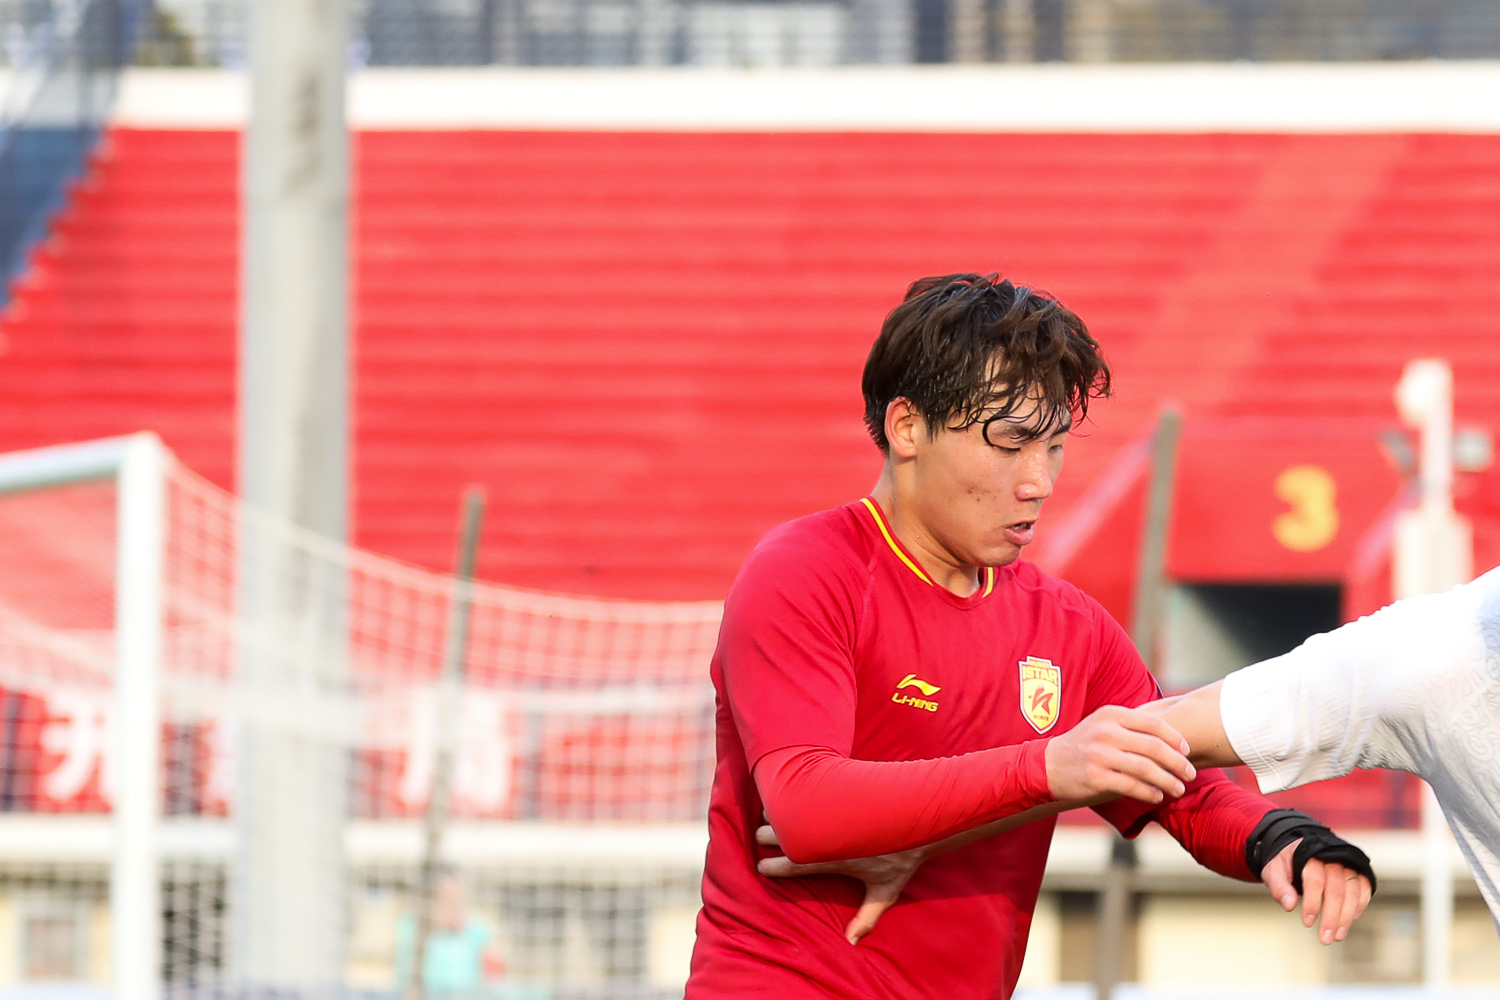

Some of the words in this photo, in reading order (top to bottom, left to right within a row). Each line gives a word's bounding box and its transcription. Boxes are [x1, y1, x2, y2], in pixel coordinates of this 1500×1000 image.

[1271, 464, 1340, 552] 3
[1022, 665, 1058, 685] ISTAR
[891, 692, 939, 712] LI-NING
